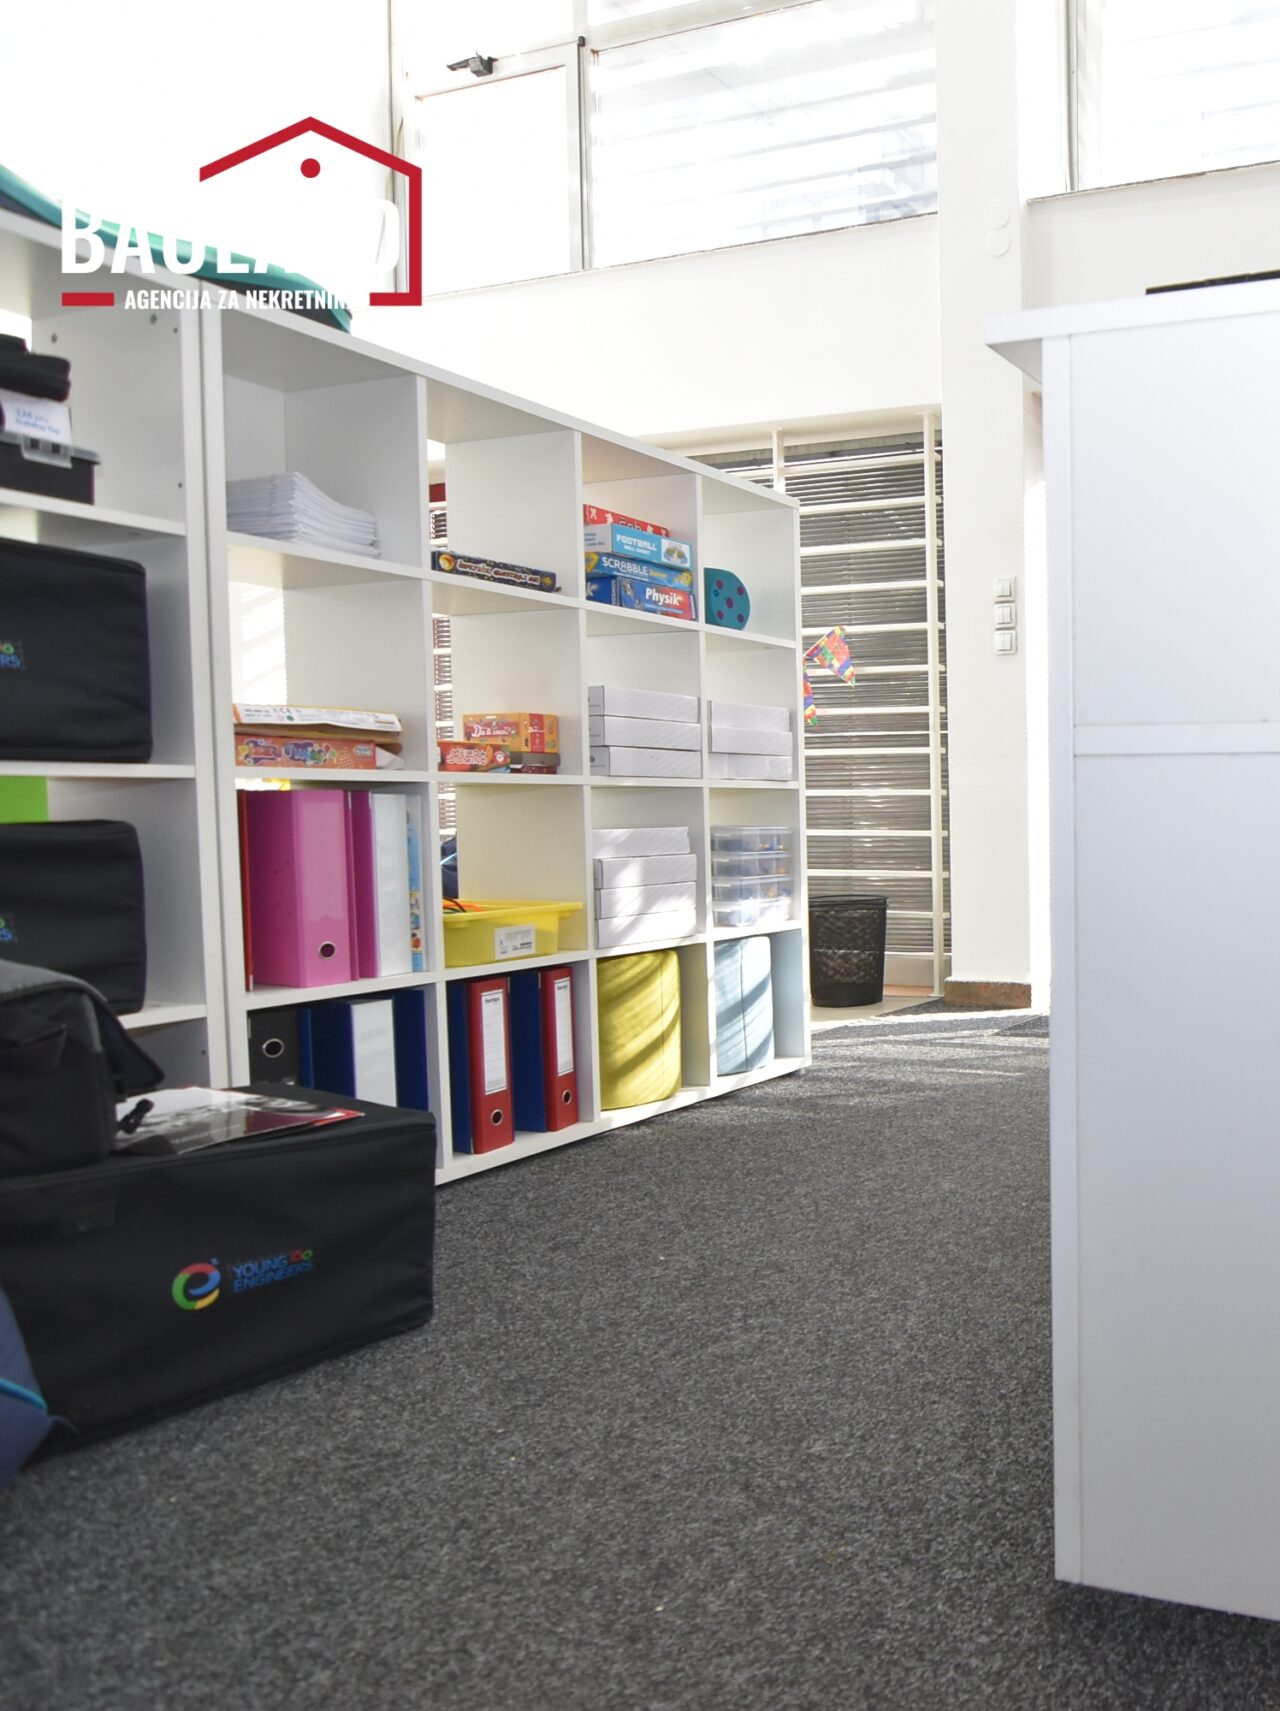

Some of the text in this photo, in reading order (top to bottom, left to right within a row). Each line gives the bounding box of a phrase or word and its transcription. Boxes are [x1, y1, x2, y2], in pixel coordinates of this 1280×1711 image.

[601, 556, 649, 577] SCRABBLE
[645, 587, 681, 606] Physik
[232, 1254, 289, 1279] YOUNG
